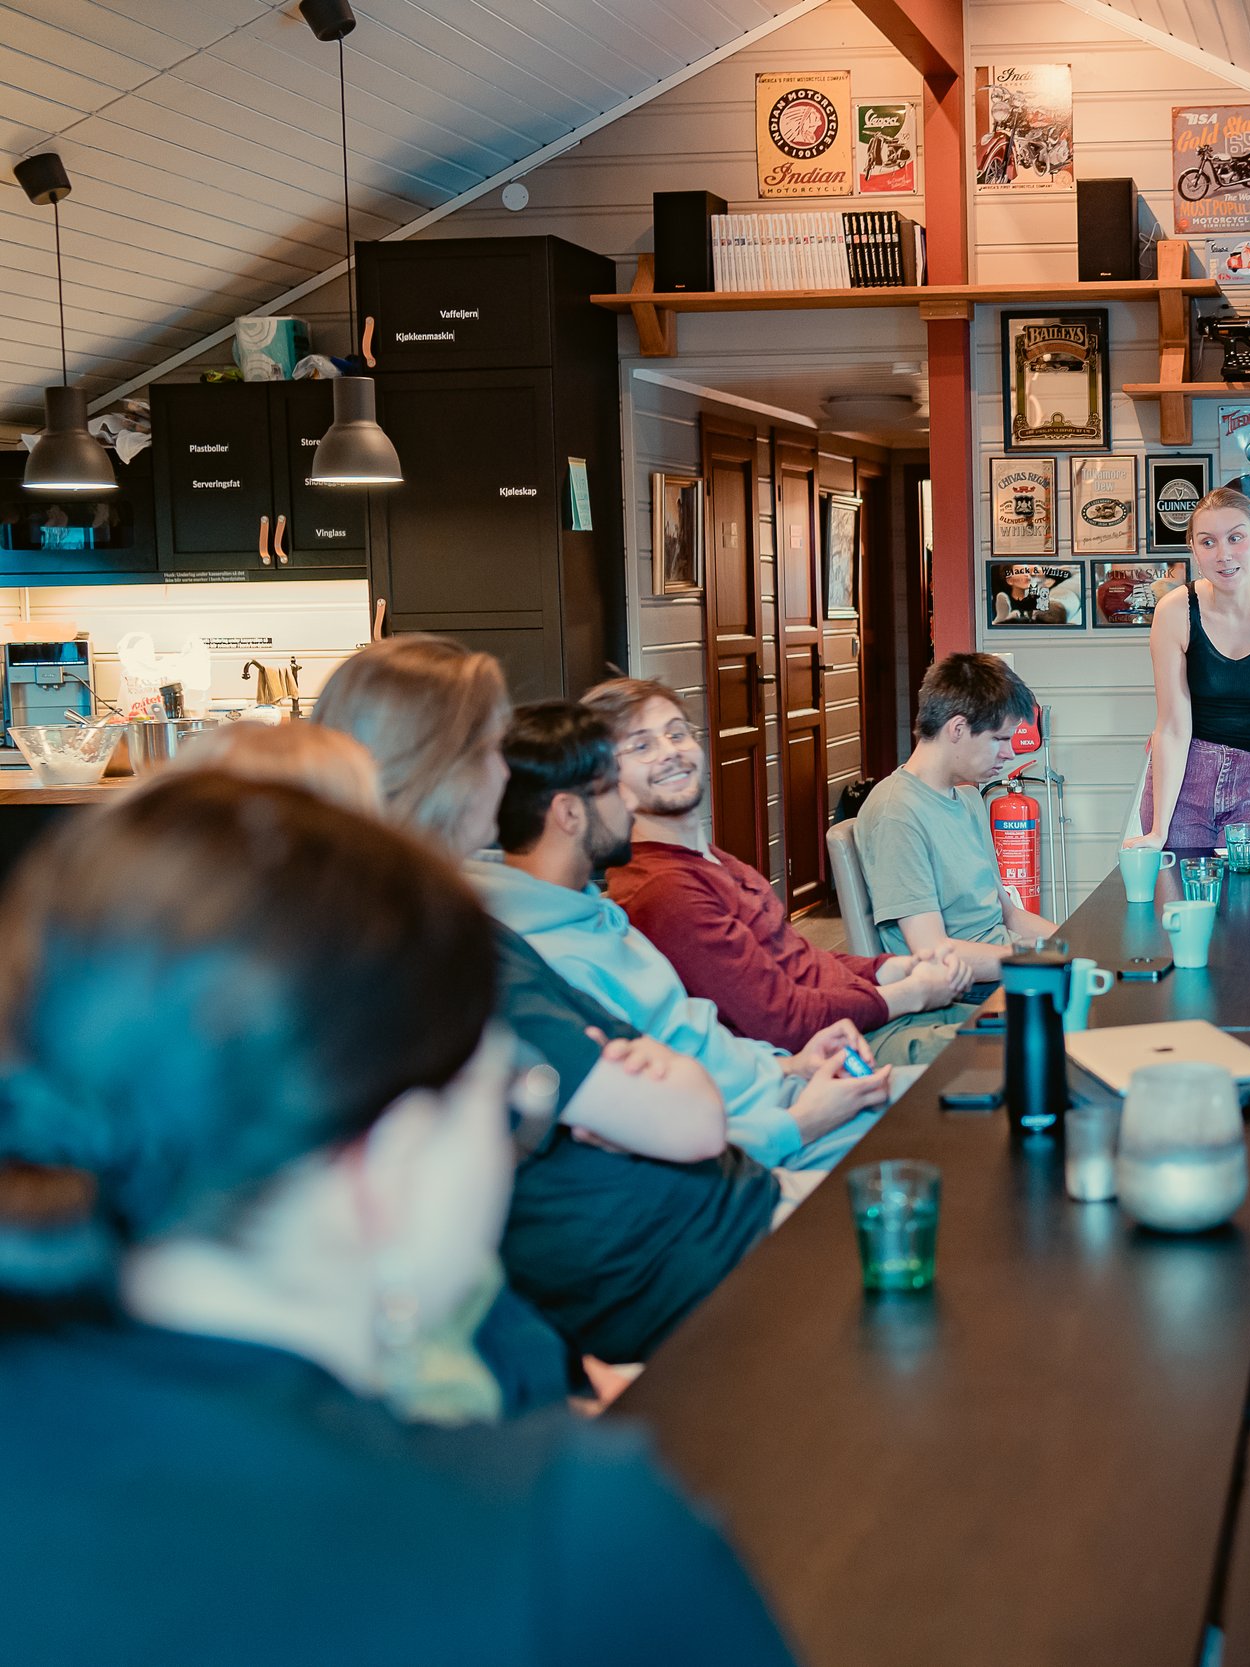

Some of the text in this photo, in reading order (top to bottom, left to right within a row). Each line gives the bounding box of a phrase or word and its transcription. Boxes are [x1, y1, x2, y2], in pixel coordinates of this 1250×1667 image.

[771, 90, 837, 148] INDIAN MOTORCYCLE
[863, 108, 900, 128] Vespa
[1184, 113, 1218, 125] BSA
[1177, 122, 1219, 152] Gold
[792, 147, 818, 158] 1901
[764, 162, 847, 186] Indian
[767, 186, 844, 194] MOTORCYCLE
[1224, 194, 1238, 202] The
[1180, 199, 1212, 217] MOST
[440, 309, 478, 319] Vaffeljern
[396, 331, 454, 342] Kjøkkenmaskin
[1029, 327, 1084, 342] BAILEYS
[189, 444, 229, 454] Plastboller
[192, 480, 241, 489] Serveringsfat
[998, 472, 1027, 490] CHIVAS
[499, 487, 537, 497] Kjøleskap
[316, 529, 346, 538] Vinglass
[1000, 525, 1049, 537] WHISKY
[1005, 567, 1030, 578] Black
[1033, 567, 1040, 575] &
[1145, 567, 1175, 580] SARK
[1002, 821, 1027, 829] SKUM
